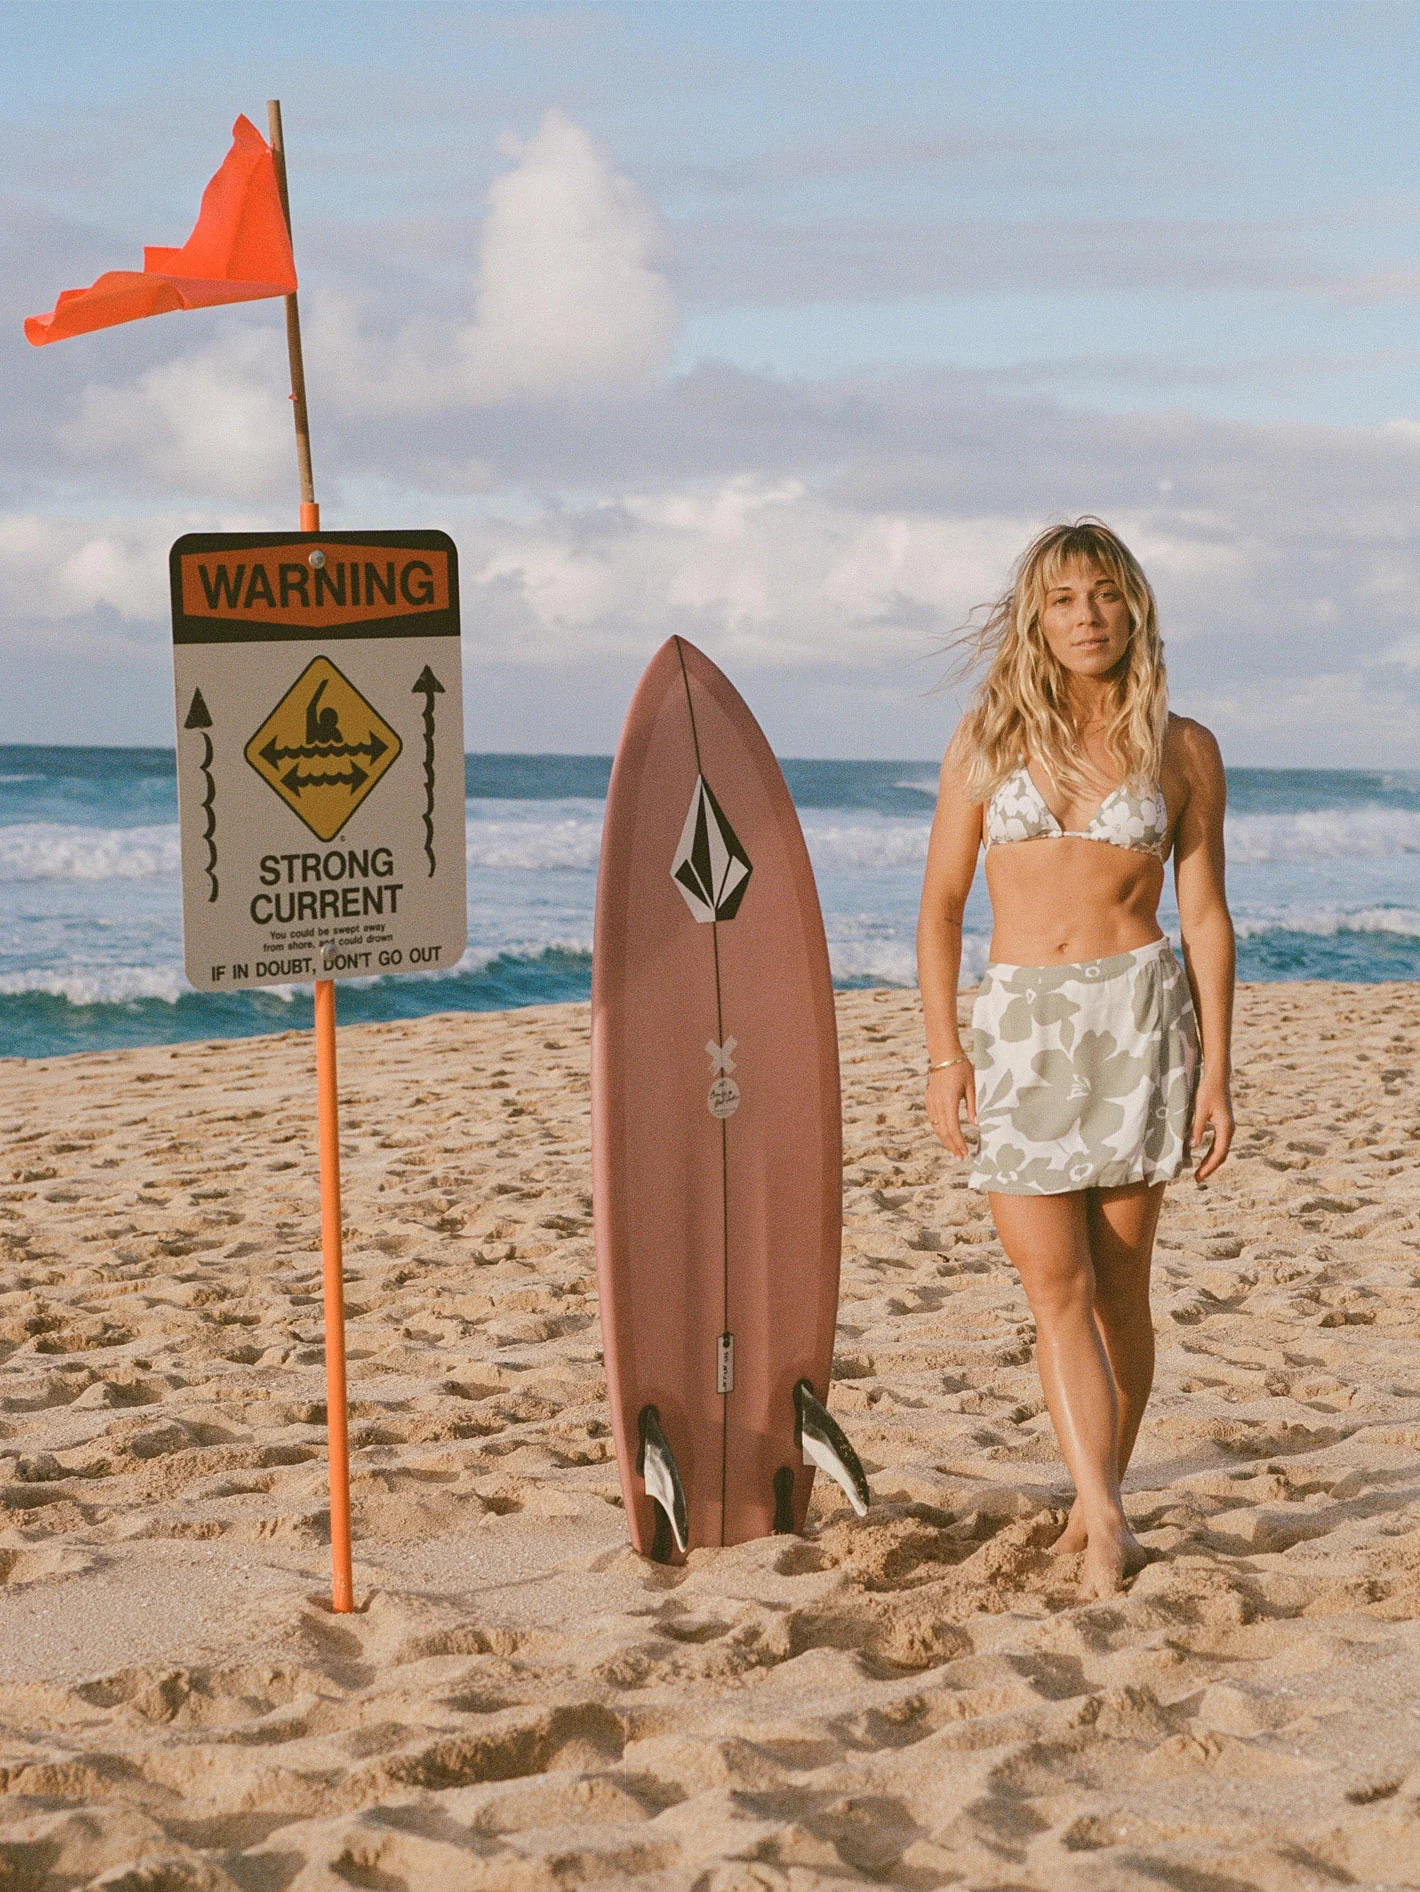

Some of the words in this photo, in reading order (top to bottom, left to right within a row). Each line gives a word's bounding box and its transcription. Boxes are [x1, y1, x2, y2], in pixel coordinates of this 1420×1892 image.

[198, 560, 435, 610] WARNING
[259, 847, 394, 886] STRONG
[250, 883, 404, 925] CURRENT
[263, 943, 284, 952] from
[338, 936, 363, 946] could
[366, 933, 393, 943] drown
[270, 931, 286, 941] You
[290, 928, 314, 938] could
[318, 927, 329, 936] be
[333, 925, 360, 935] swept
[363, 923, 386, 933] away
[211, 966, 226, 981] IF
[233, 963, 249, 979] IN
[256, 957, 316, 977] DOUBT,
[323, 952, 372, 971] DON'T
[378, 949, 403, 966] GO
[409, 946, 442, 963] OUT
